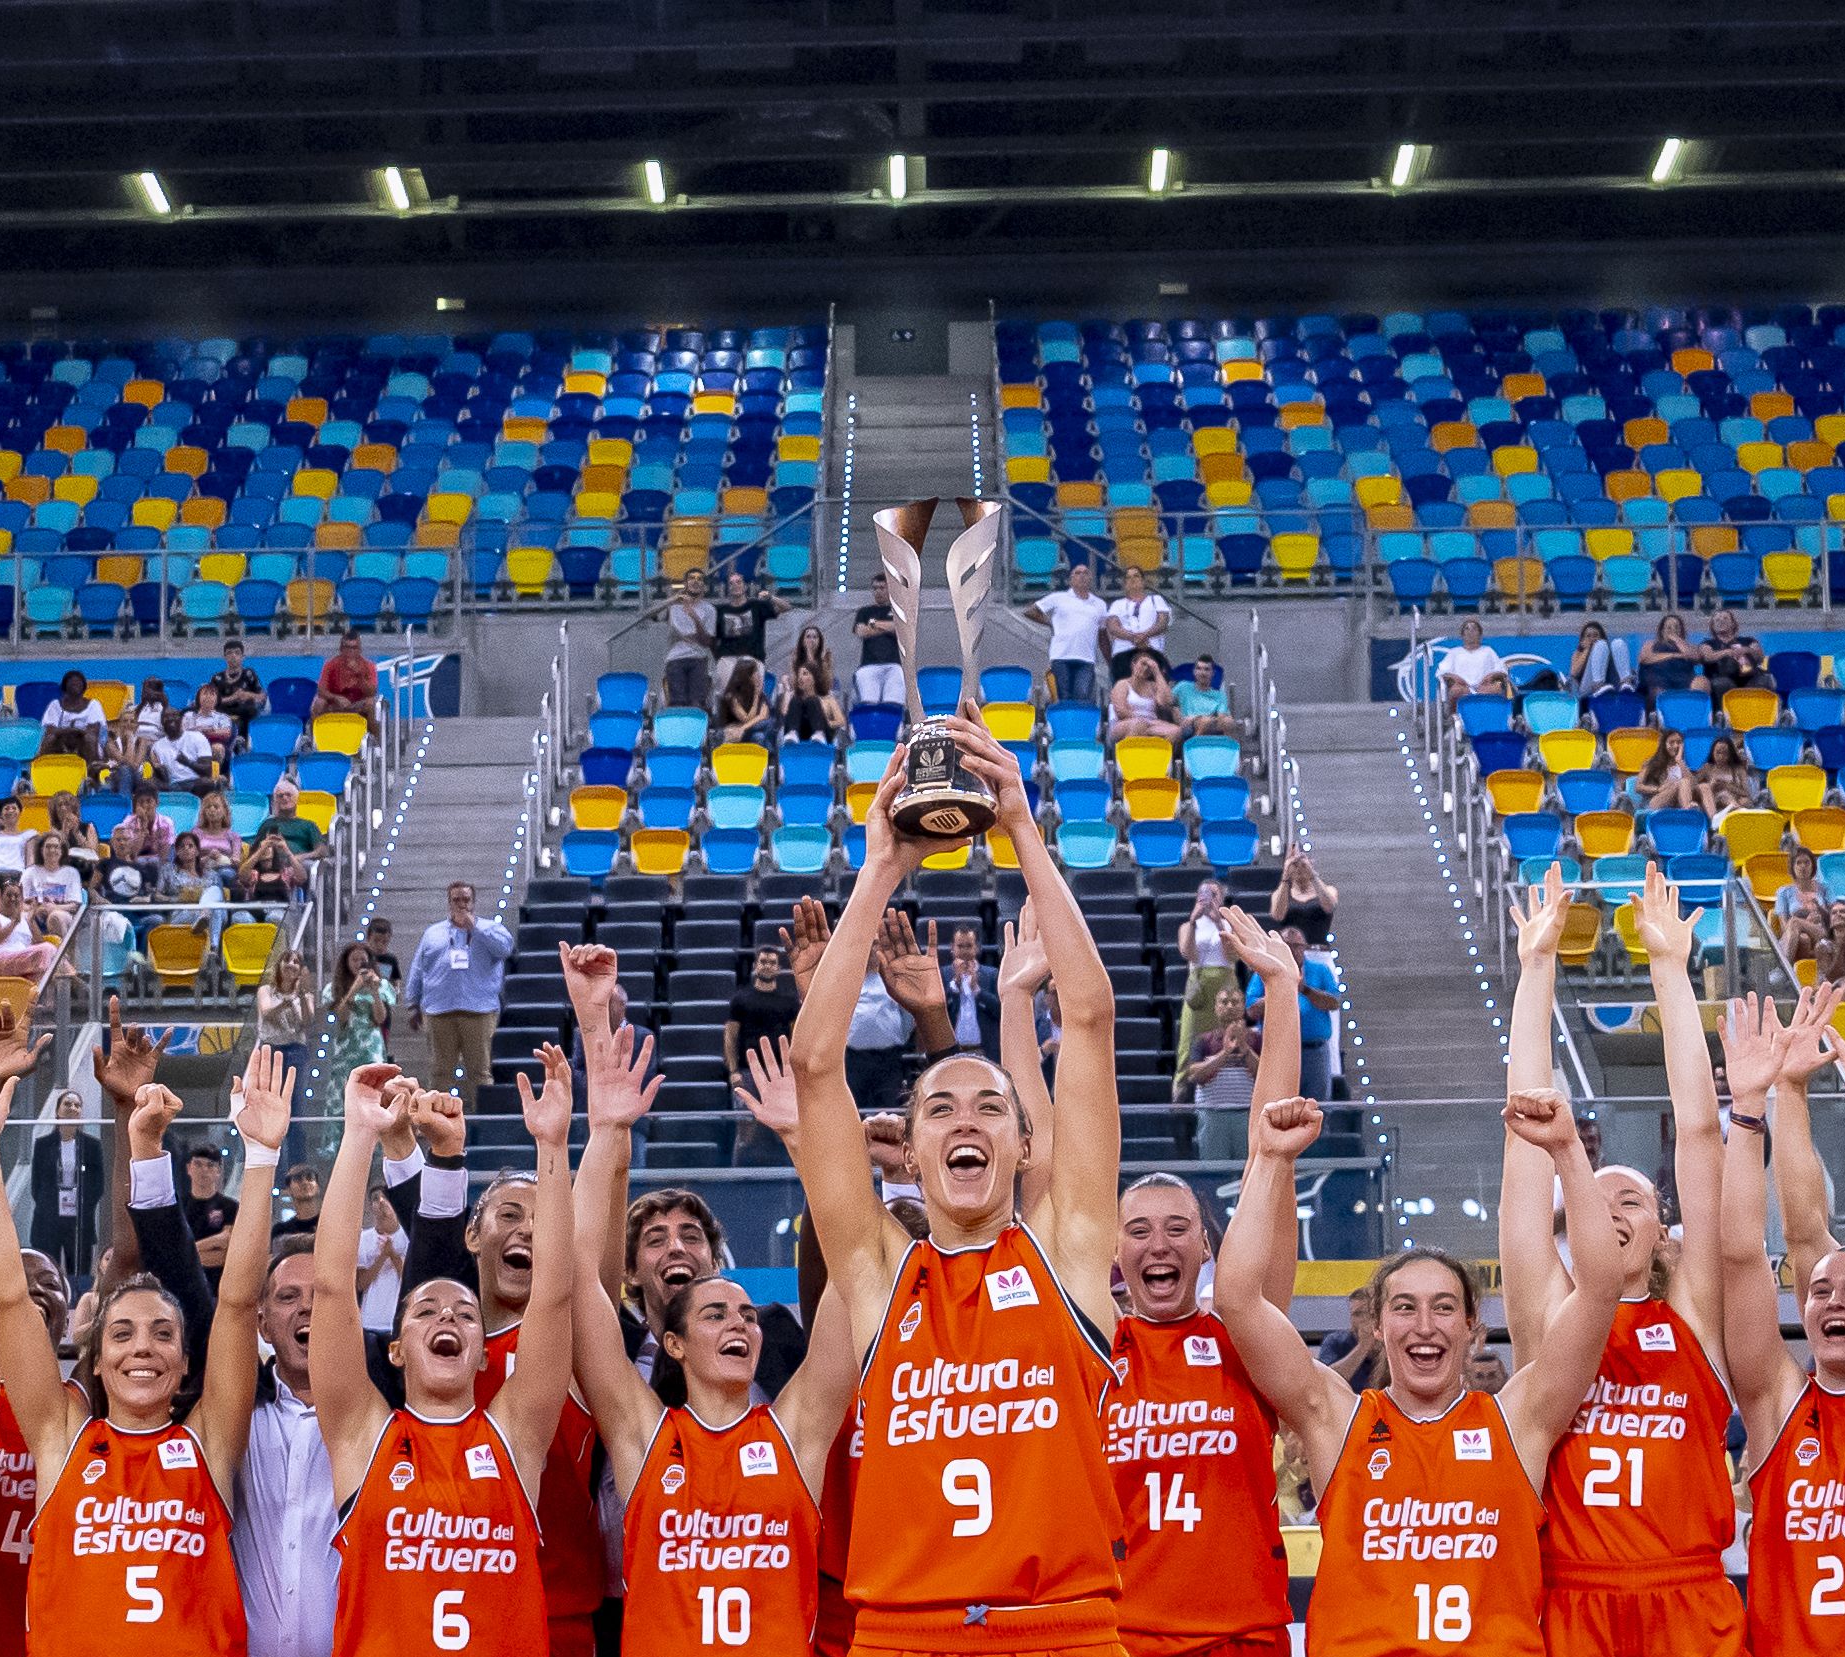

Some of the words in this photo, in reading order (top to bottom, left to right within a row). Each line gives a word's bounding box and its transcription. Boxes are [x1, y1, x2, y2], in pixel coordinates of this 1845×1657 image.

[891, 1358, 1019, 1400] Cultura
[1022, 1363, 1055, 1387] del
[1211, 1405, 1234, 1422] del
[1664, 1389, 1687, 1408] del
[887, 1396, 1058, 1447] Esfuerzo
[1582, 1447, 1644, 1506] 21
[76, 1496, 184, 1526] Cultura
[185, 1506, 205, 1525] del
[941, 1458, 992, 1536] 9
[1144, 1472, 1202, 1532] 14
[1364, 1497, 1472, 1527] Cultura
[1476, 1507, 1499, 1526] del
[73, 1524, 206, 1557] Esfuerzo
[386, 1507, 490, 1540] Cultura
[493, 1523, 514, 1541] del
[659, 1509, 763, 1539] Cultura
[765, 1518, 788, 1536] del
[385, 1538, 516, 1574] Esfuerzo
[658, 1540, 789, 1572] Esfuerzo
[1362, 1527, 1497, 1561] Esfuerzo
[125, 1566, 164, 1623] 5
[1412, 1583, 1471, 1642] 18
[432, 1590, 471, 1650] 6
[698, 1586, 751, 1646] 10
